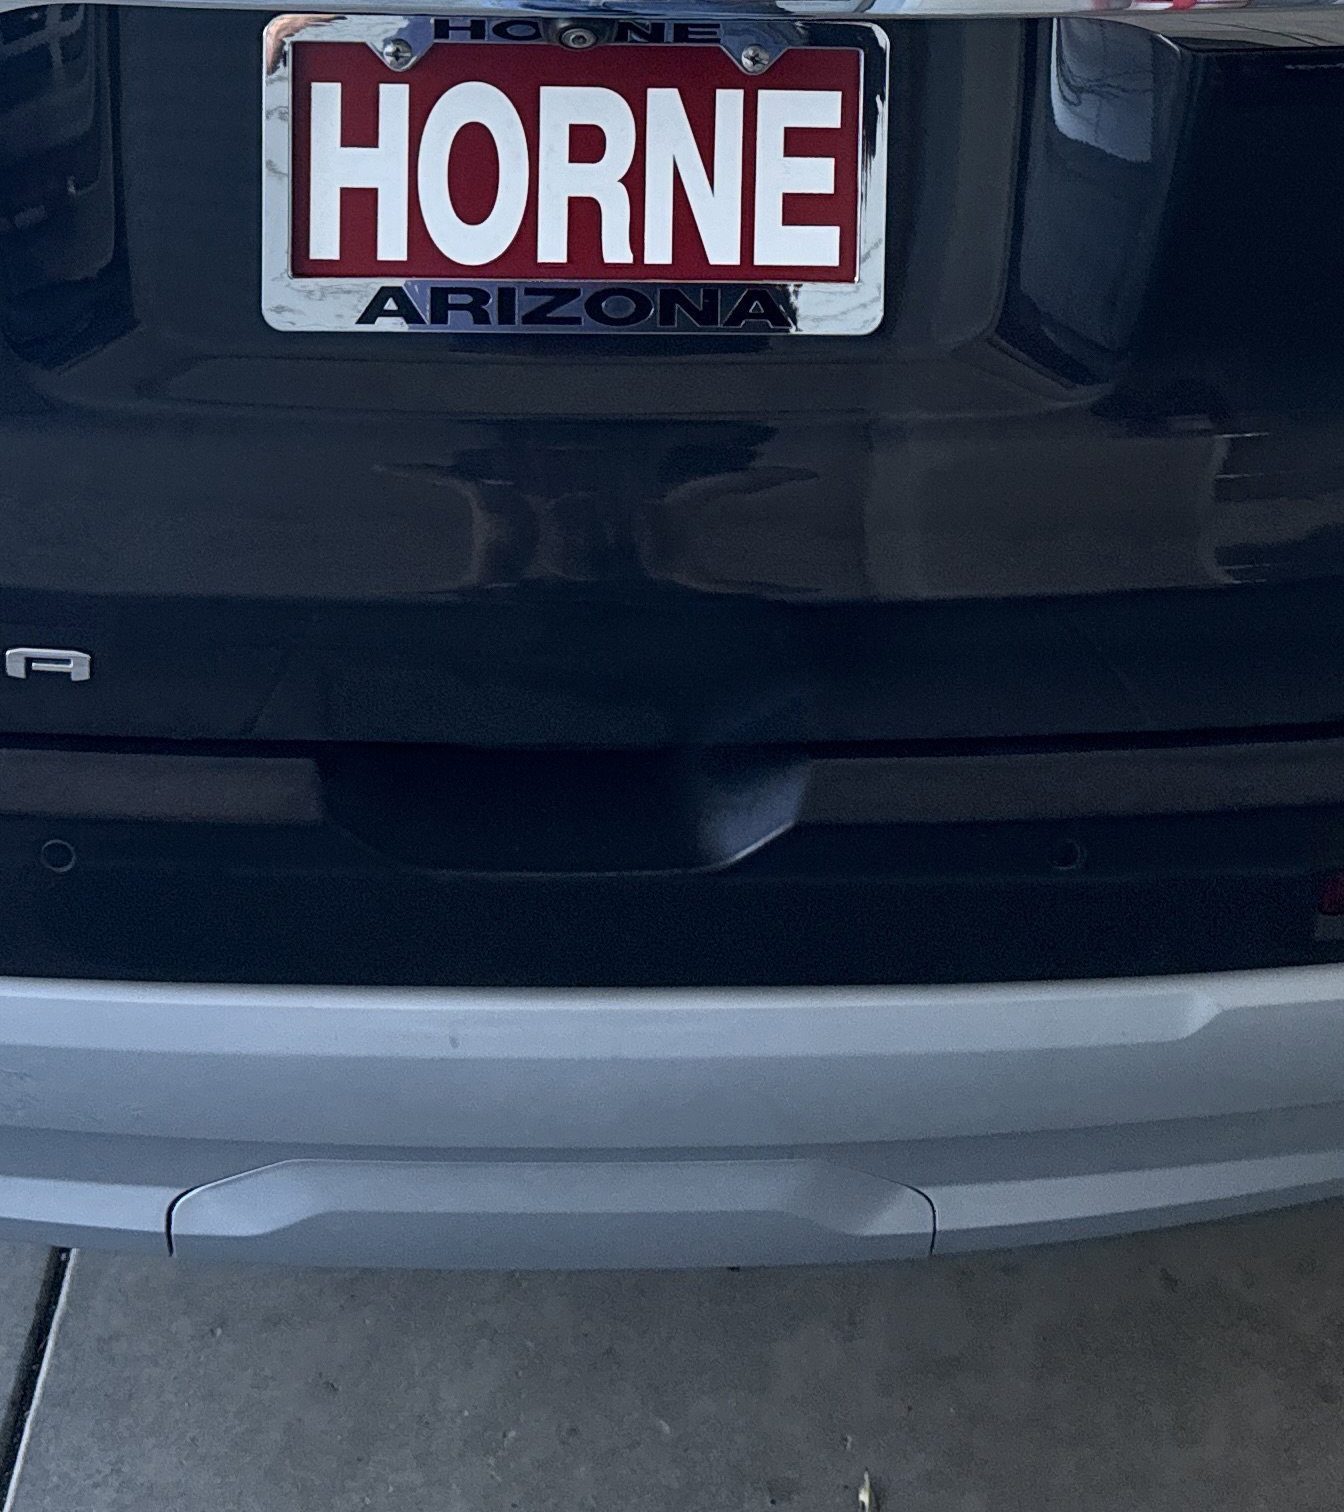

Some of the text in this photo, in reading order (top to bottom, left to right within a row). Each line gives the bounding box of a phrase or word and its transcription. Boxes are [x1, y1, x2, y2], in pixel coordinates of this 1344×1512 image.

[433, 19, 722, 44] HONE
[309, 81, 843, 266] HORNE
[356, 285, 794, 329] ARIZONA
